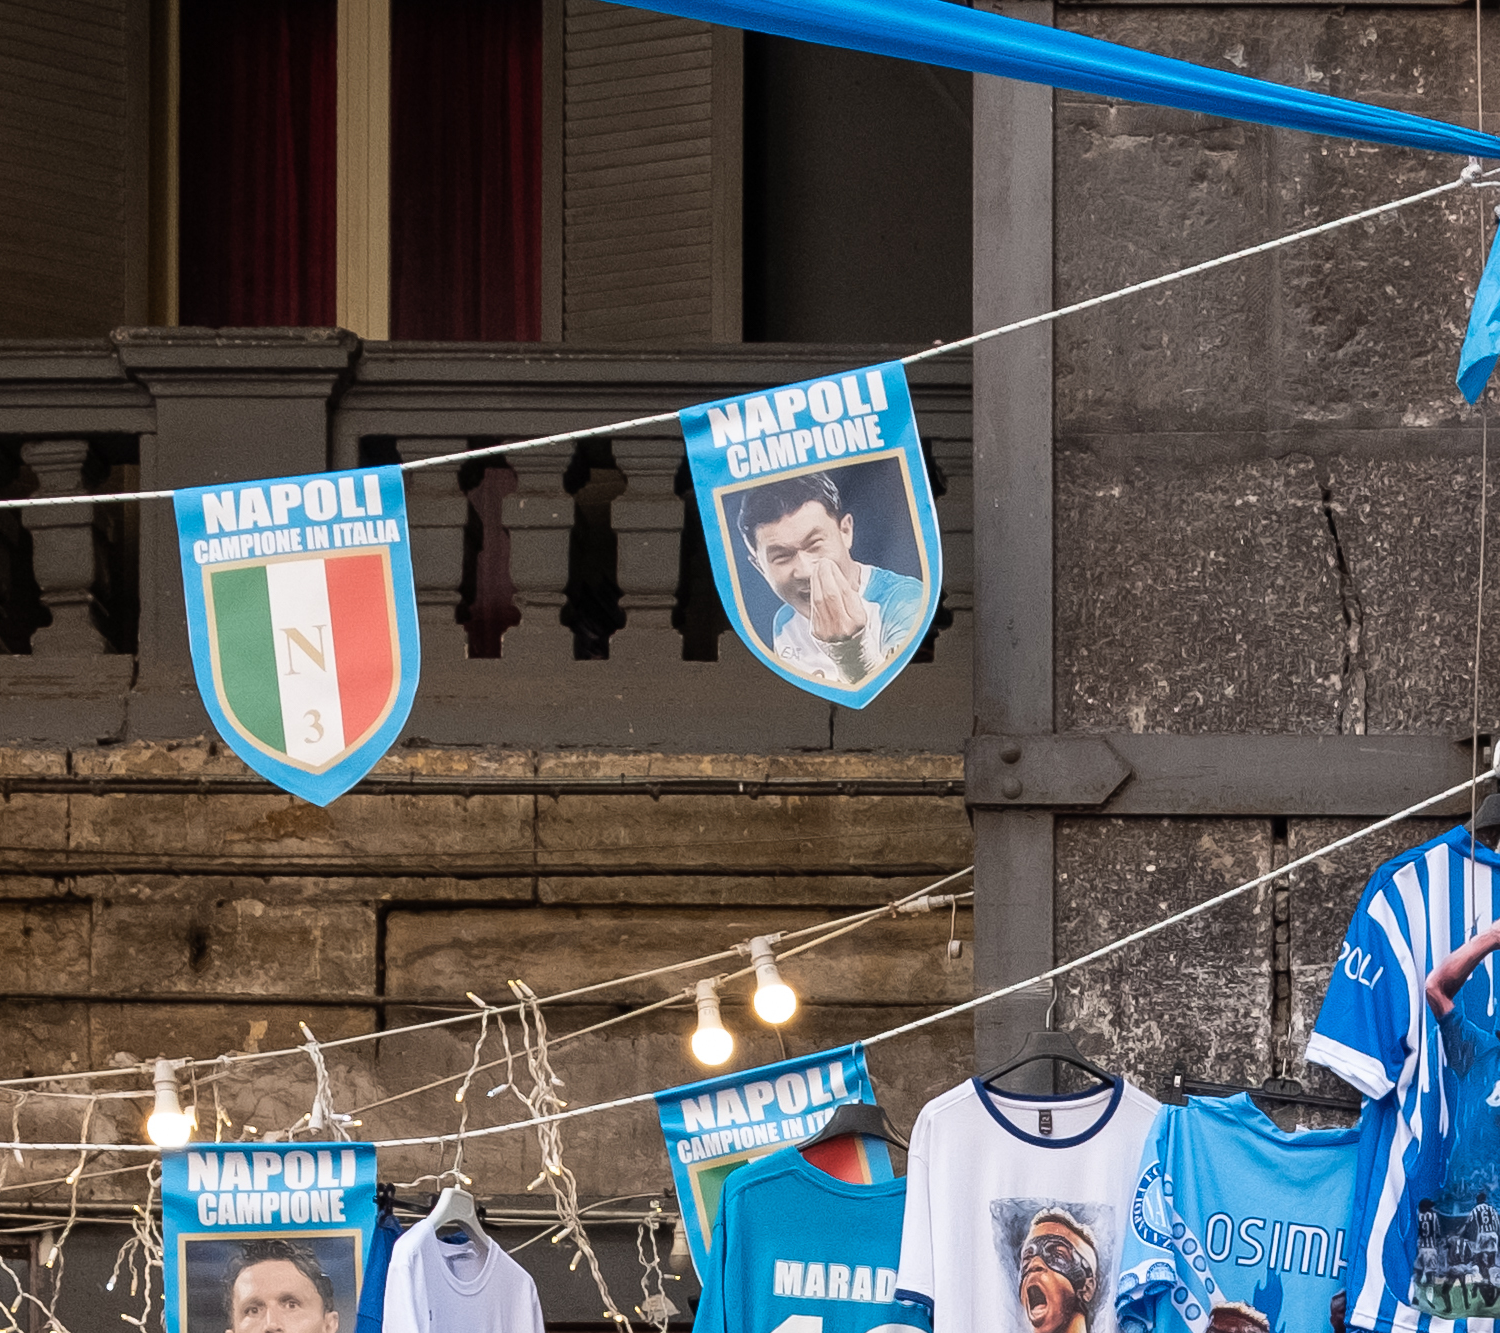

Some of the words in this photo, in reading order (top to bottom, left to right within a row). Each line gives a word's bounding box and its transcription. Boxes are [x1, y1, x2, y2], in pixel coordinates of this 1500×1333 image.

[707, 370, 888, 448] NAPOLI
[727, 414, 885, 478] CAMPIONE
[202, 475, 384, 534] NAPOLI
[192, 530, 303, 565] CAMPIONE
[305, 526, 330, 551] IN
[332, 519, 401, 547] ITALIA
[282, 625, 328, 675] N
[303, 709, 325, 745] 3
[681, 1061, 848, 1133] NAPOLI
[677, 1122, 780, 1164] CAMPIONE
[781, 1117, 805, 1140] IN
[188, 1149, 356, 1193] NAPOLI
[198, 1189, 346, 1226] CAMPIONE
